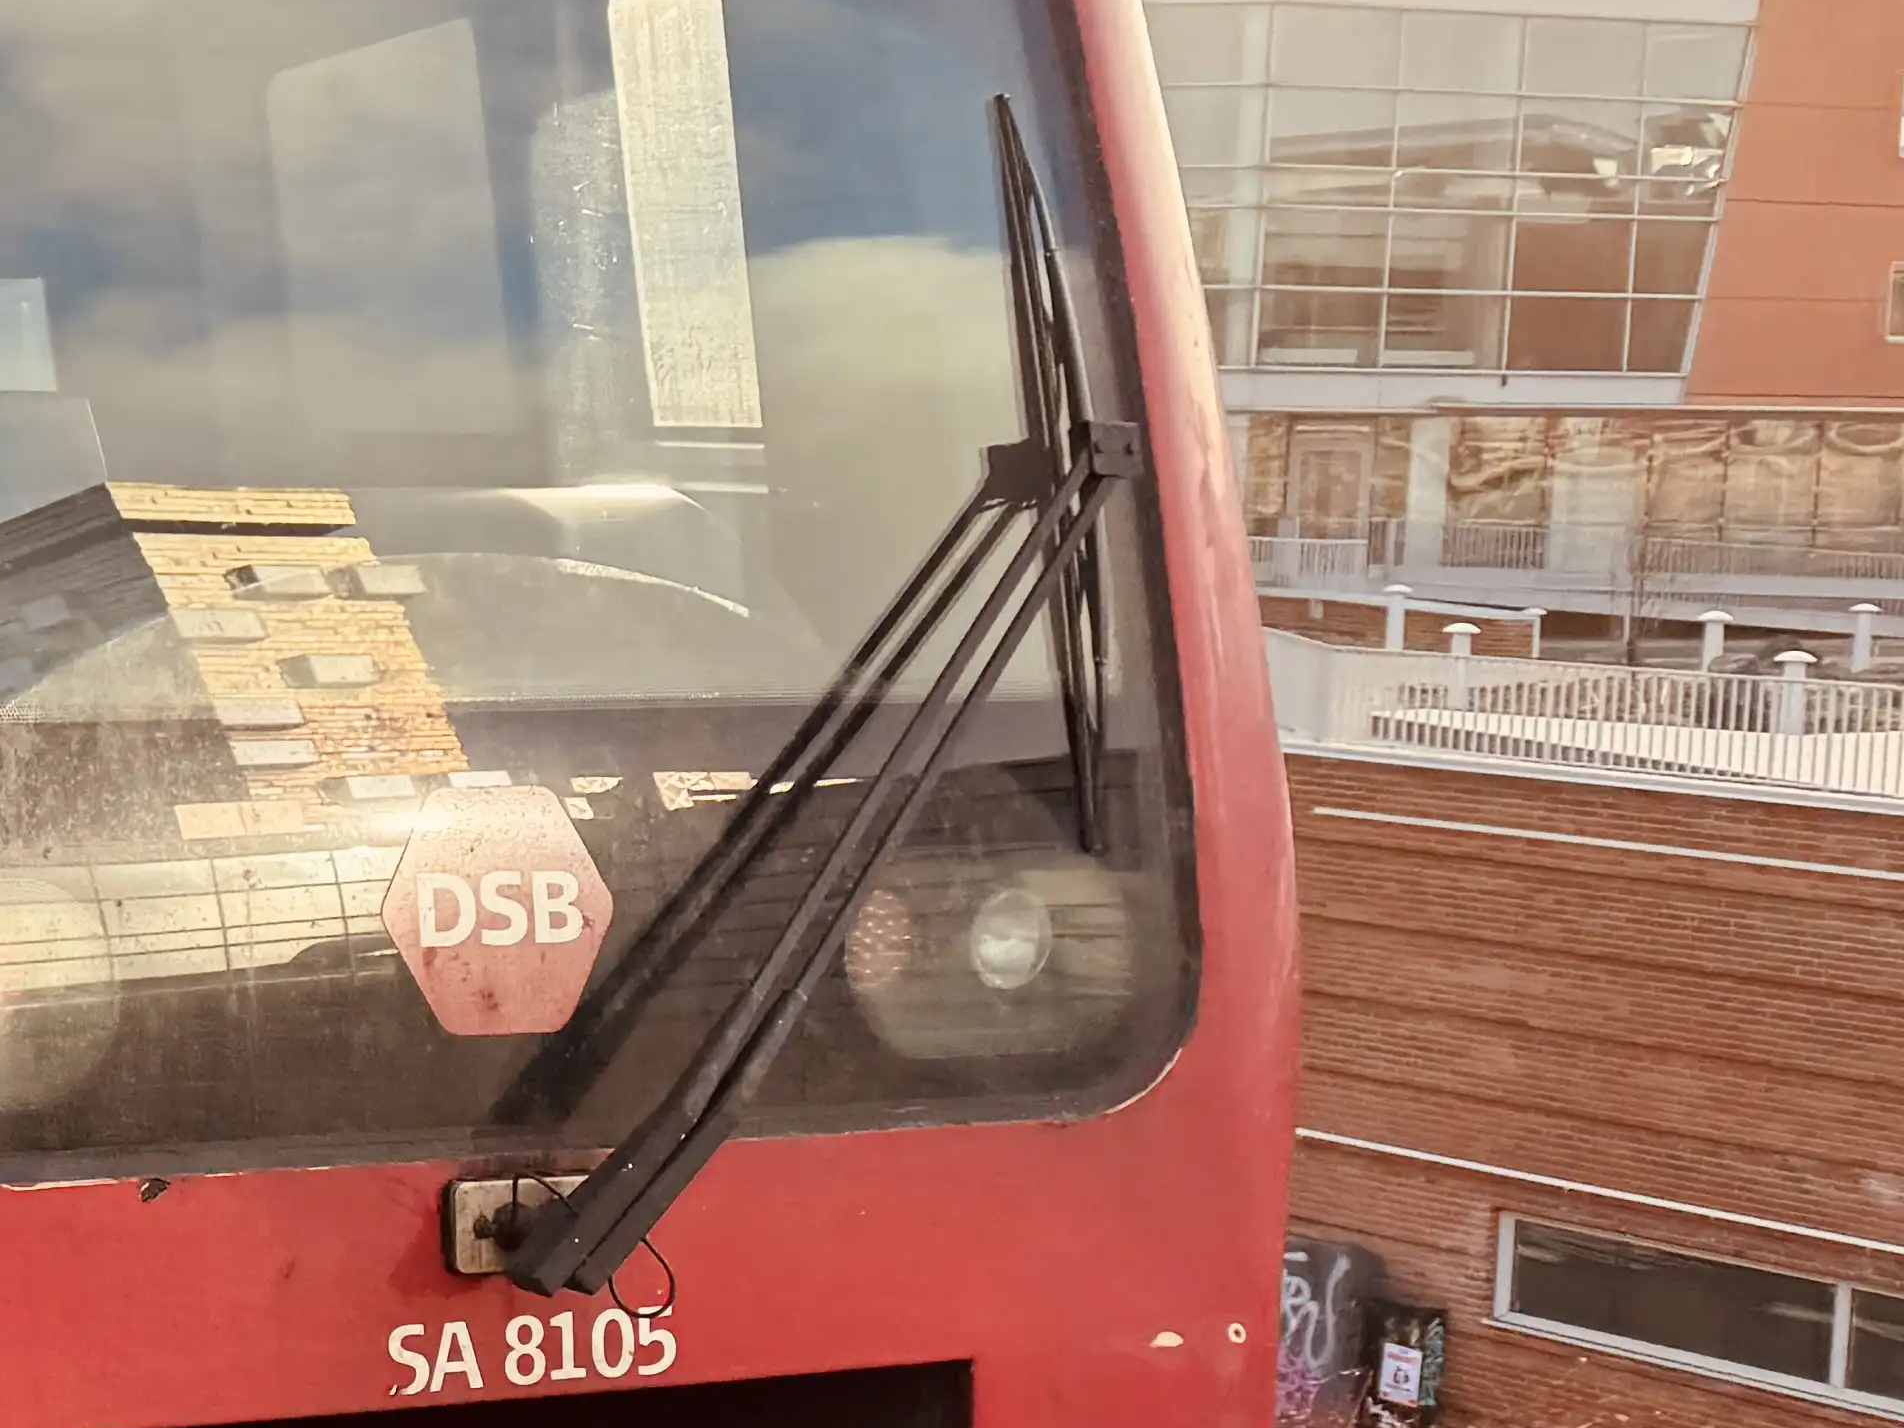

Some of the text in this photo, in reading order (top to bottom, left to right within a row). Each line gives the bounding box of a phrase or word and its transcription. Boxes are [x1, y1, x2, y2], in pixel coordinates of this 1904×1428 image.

[415, 869, 584, 949] DSB
[387, 1305, 678, 1397] SA 8105
